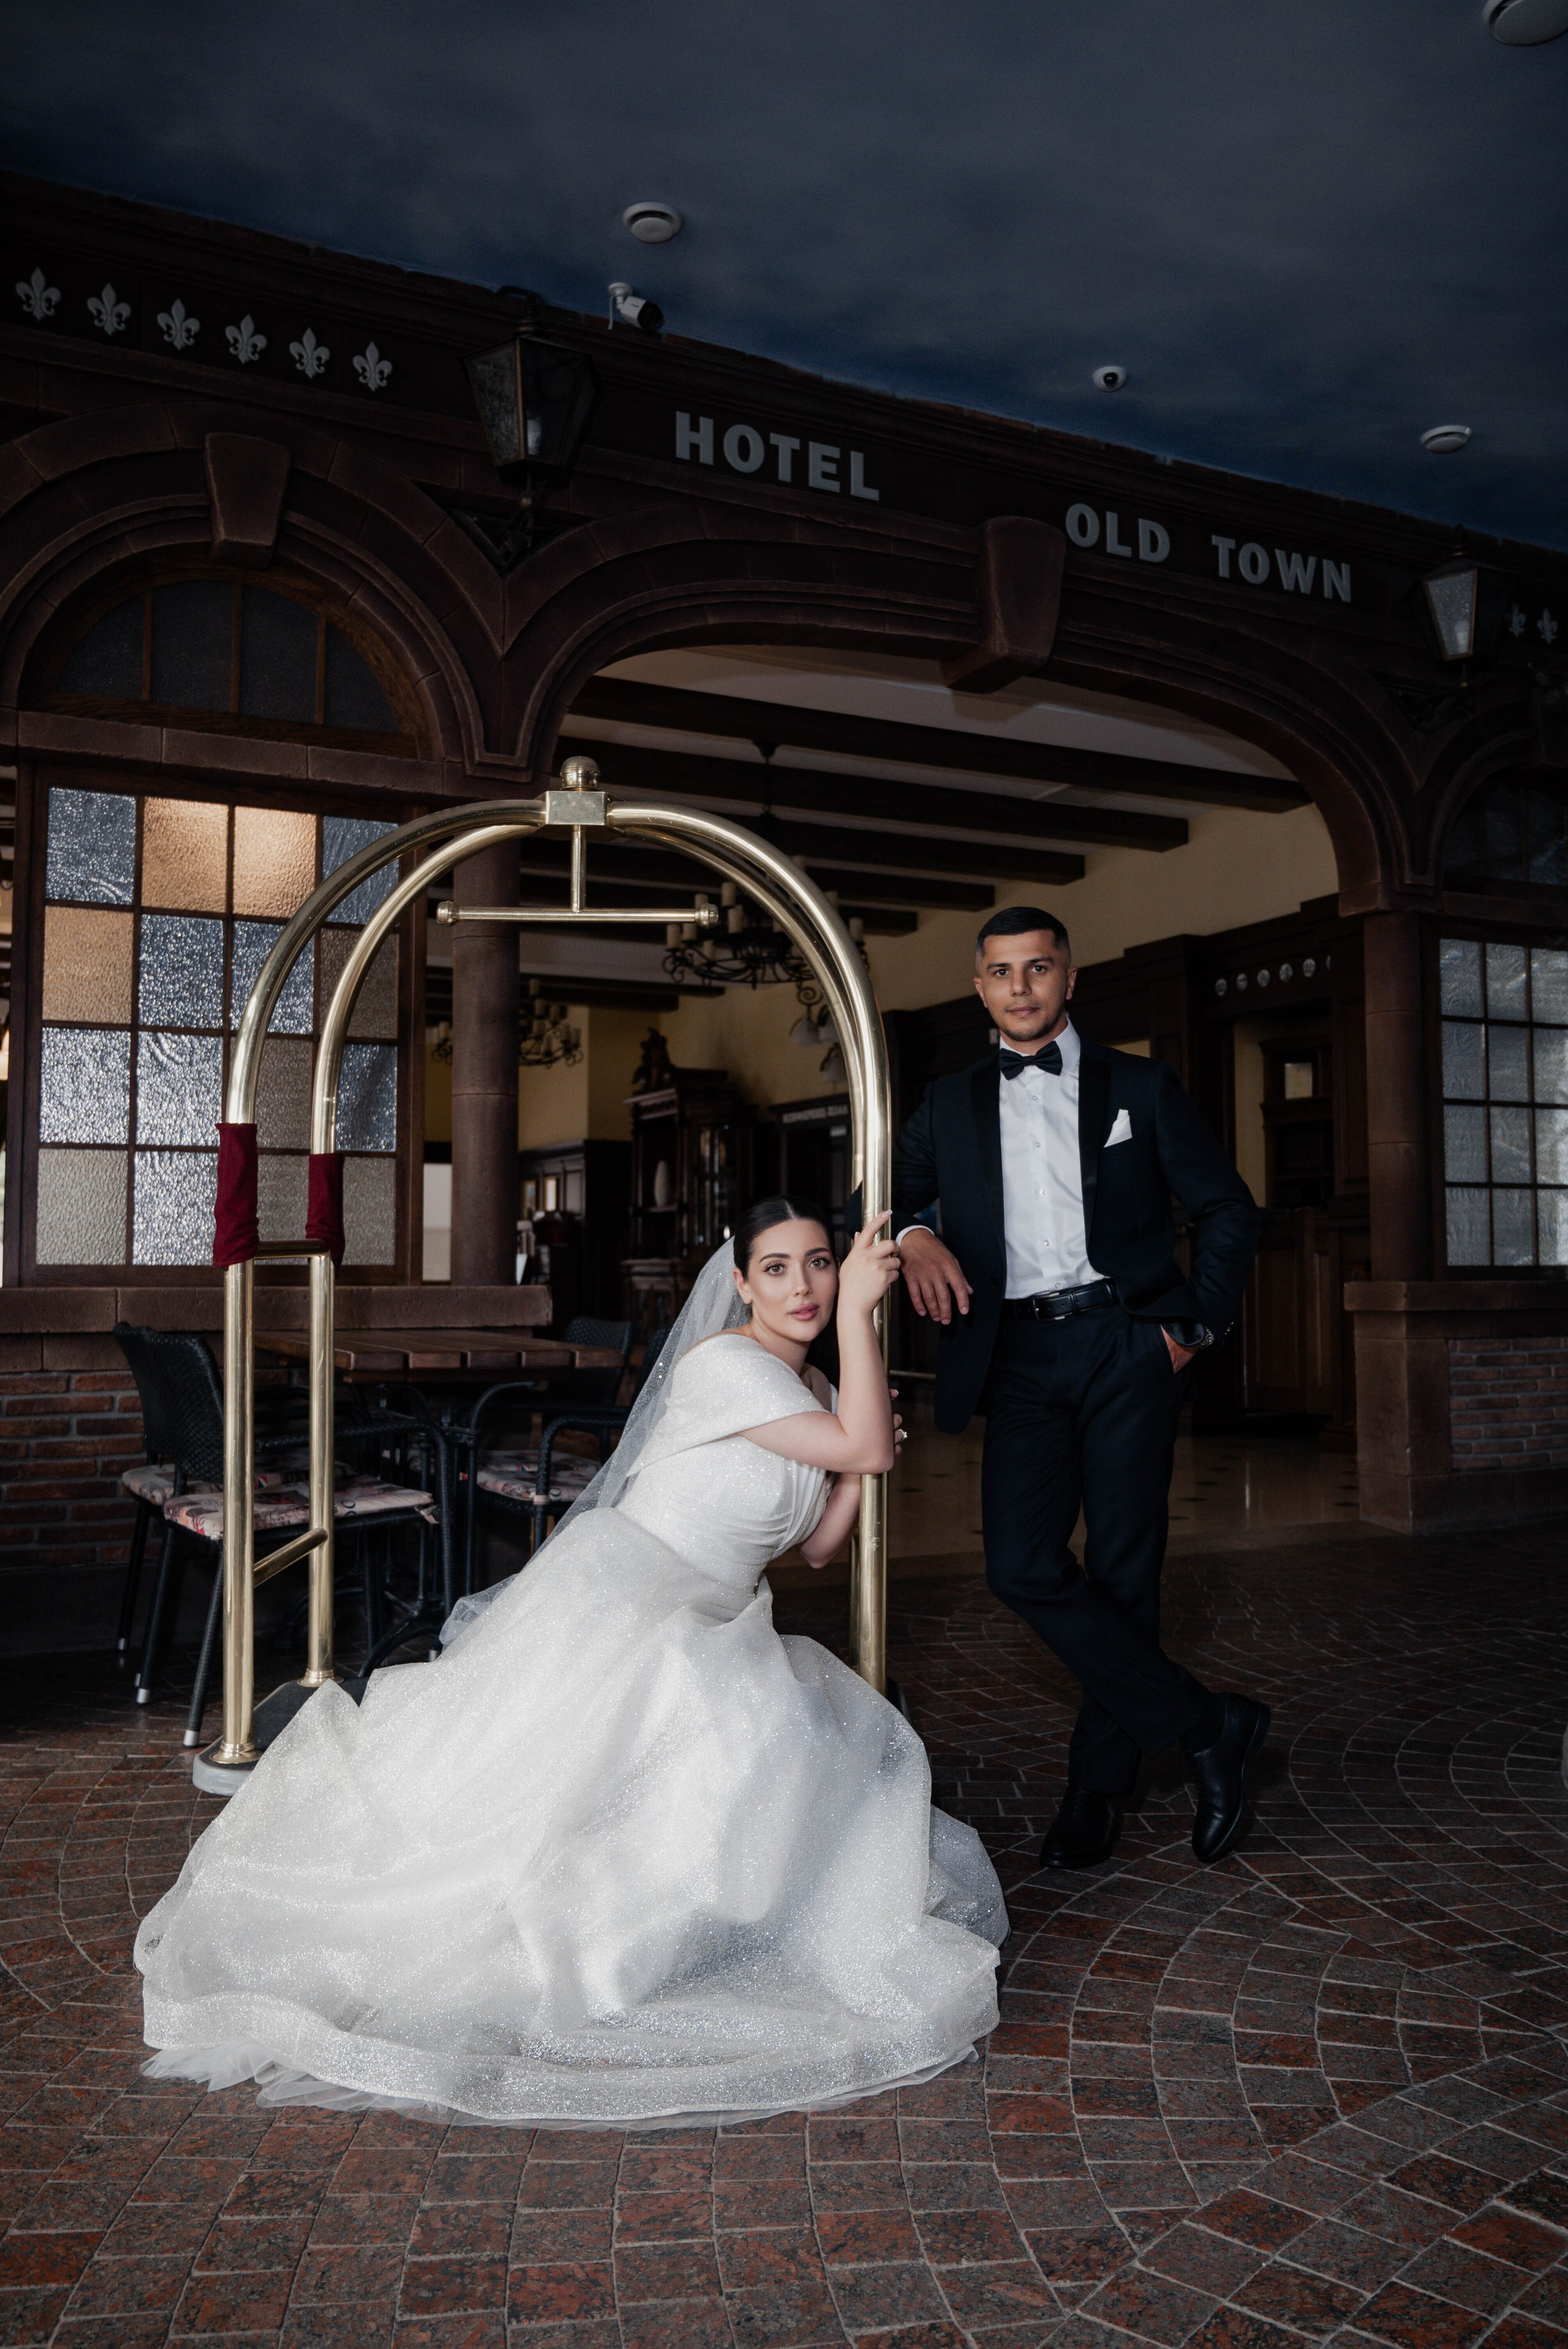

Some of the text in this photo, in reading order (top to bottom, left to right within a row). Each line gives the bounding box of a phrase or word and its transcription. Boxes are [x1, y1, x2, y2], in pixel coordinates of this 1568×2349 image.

[674, 411, 1351, 602] HOTEL OLD TOWN
